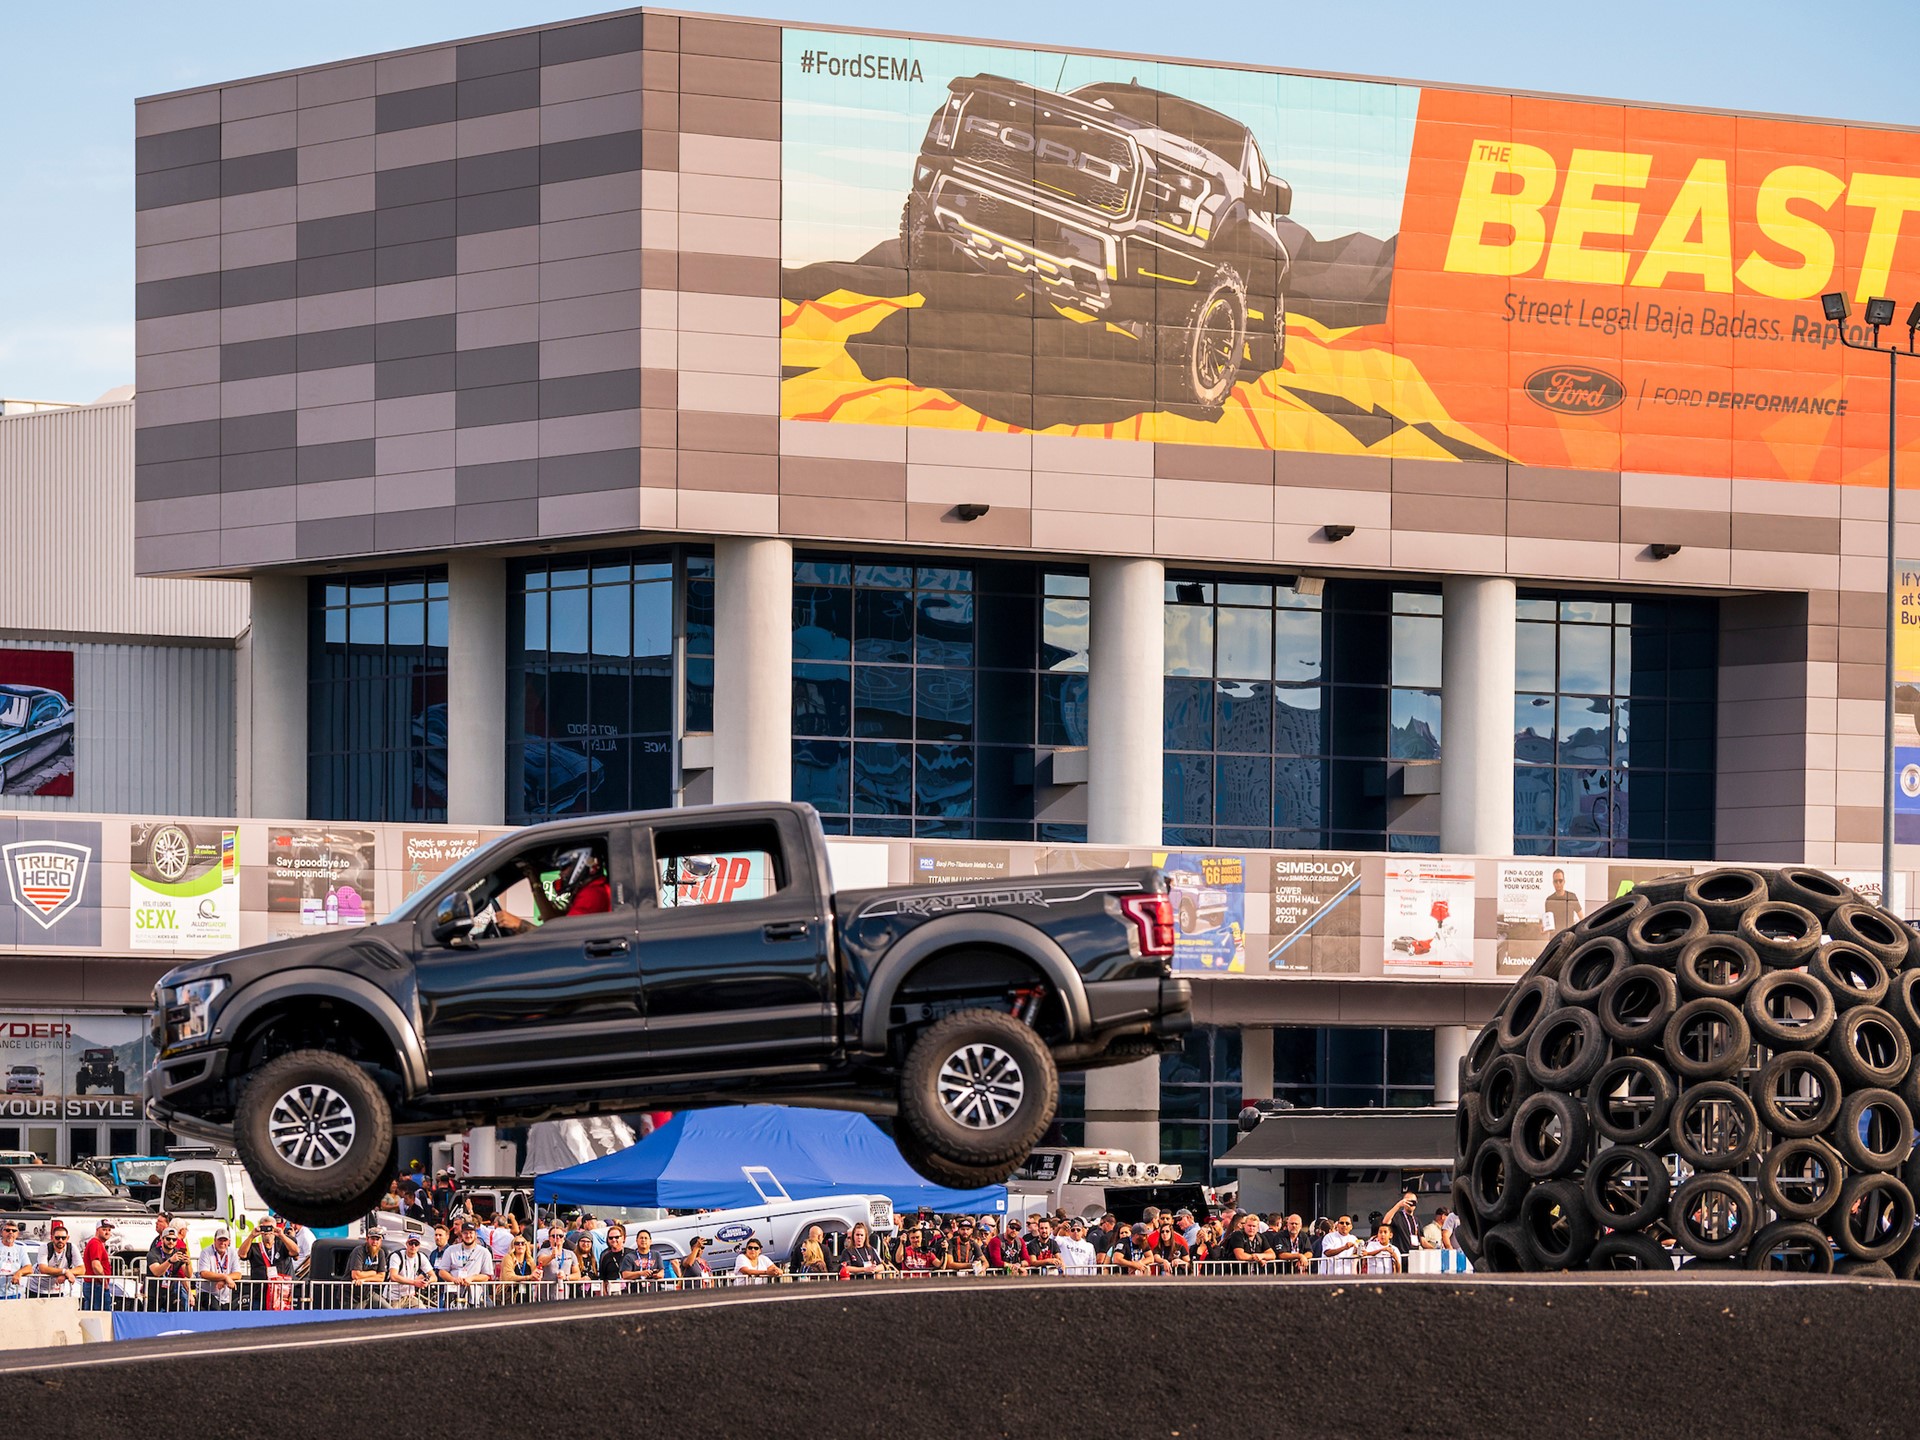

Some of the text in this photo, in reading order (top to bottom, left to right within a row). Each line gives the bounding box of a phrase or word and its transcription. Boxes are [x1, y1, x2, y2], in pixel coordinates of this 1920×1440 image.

[800, 49, 924, 84] #FordSEMA
[964, 115, 1121, 184] FORD
[1477, 144, 1511, 163] THE
[1443, 139, 1920, 303] BEAST
[1501, 293, 1573, 326] Street
[1578, 299, 1639, 335] Legal
[1645, 304, 1693, 339] Baja
[1700, 308, 1785, 341] Badass.
[1543, 371, 1607, 408] Ford
[1653, 387, 1849, 418] FORD PERFORMANCE
[1901, 572, 1910, 586] If
[1901, 593, 1914, 606] at
[276, 857, 292, 868] Say
[341, 859, 350, 868] to
[407, 846, 442, 863] Booth
[17, 855, 75, 872] TRUCK
[1276, 860, 1355, 878] SIMBOLOX
[23, 870, 71, 886] HERO
[276, 869, 340, 880] compounding.
[1276, 886, 1301, 895] LOWER
[896, 889, 1050, 917] RAPTOR
[1276, 895, 1320, 904] SOUTH HALL
[135, 909, 179, 929] SEXY.
[1275, 915, 1297, 923] 47221
[1276, 907, 1300, 915] BOOTH
[0, 1041, 71, 1050] NCE LIGHTING
[67, 1100, 134, 1117] STYLE
